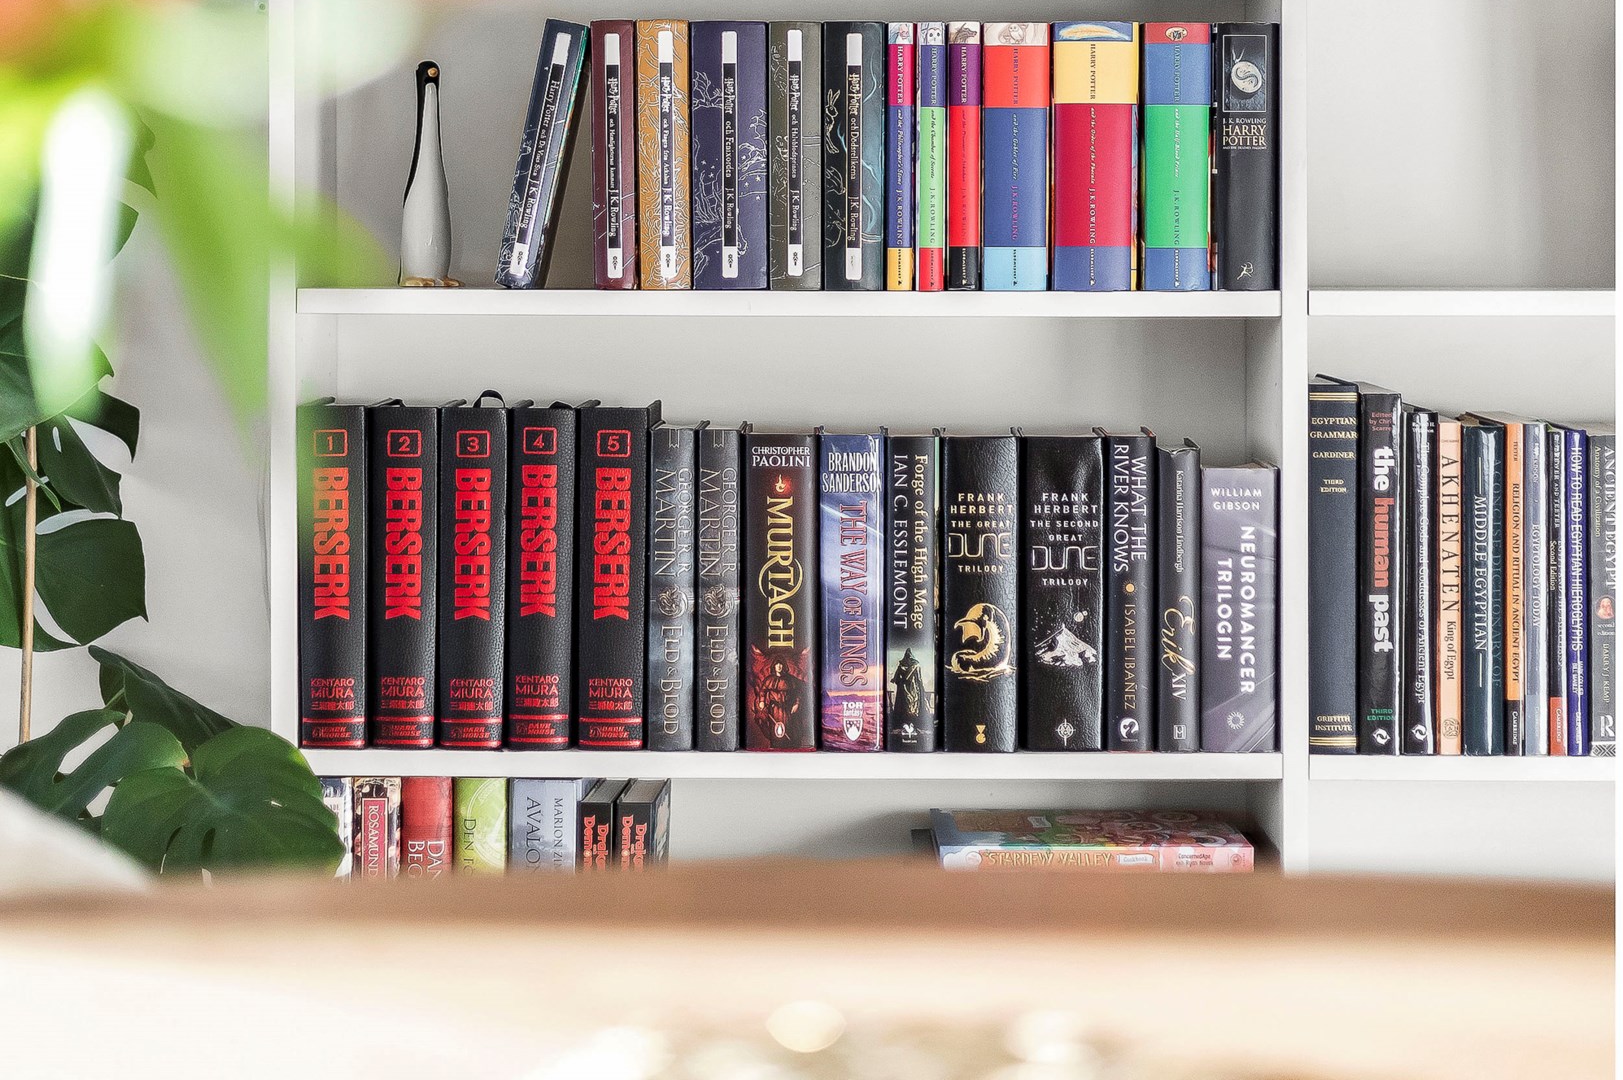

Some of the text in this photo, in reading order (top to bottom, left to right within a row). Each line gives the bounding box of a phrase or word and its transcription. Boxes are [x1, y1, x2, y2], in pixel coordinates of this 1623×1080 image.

[1223, 124, 1267, 136] HARRY
[1223, 136, 1267, 147] POTTER
[399, 436, 411, 453] 2
[467, 436, 480, 452] 3
[534, 434, 545, 447] 4
[607, 435, 620, 451] 5
[751, 446, 811, 455] CHRISTOPHER
[1309, 431, 1358, 439] GRAMMAR
[1311, 416, 1358, 426] EGYPTIAN
[752, 456, 811, 467] PAOLINI
[822, 473, 882, 493] SANDERSON
[828, 453, 878, 471] BRANDON
[678, 467, 692, 540] GEORGE
[950, 505, 1013, 514] HERBERT
[958, 493, 1004, 502] FRANK
[1114, 444, 1129, 572] RIVER KNOWS
[1131, 456, 1147, 561] WHAT THE
[1210, 488, 1262, 497] WILLIAM
[1213, 502, 1260, 510] GIBSON
[313, 467, 350, 620] BERSERK
[386, 467, 423, 620] BERSERK
[455, 468, 492, 620] BERSERK
[521, 464, 558, 617] BERSERK
[593, 468, 631, 620] BERSERK
[655, 468, 675, 578] MARTIN
[893, 454, 908, 629] IAN ESSLEMONT
[912, 454, 928, 629] Forge High Mage
[1369, 446, 1394, 653] the human past
[1442, 456, 1459, 613] AKHENATEN
[764, 496, 797, 649] MURTAGH
[840, 500, 868, 686] THE WAY OF KINGS
[1473, 495, 1487, 651] MIDDLE EGYPTIAN
[1217, 558, 1232, 659] TRILOGIN
[1240, 526, 1256, 693] NEUROMANCER
[661, 624, 682, 734] ELD BLOD
[1124, 604, 1138, 710] ISABEL IBAÑEZ
[1445, 620, 1457, 680] King of Egypt
[589, 678, 633, 686] KENTARO
[589, 687, 633, 698] MIURA
[554, 797, 563, 848] MARION
[986, 850, 1113, 867] STARDEW VALLEY
